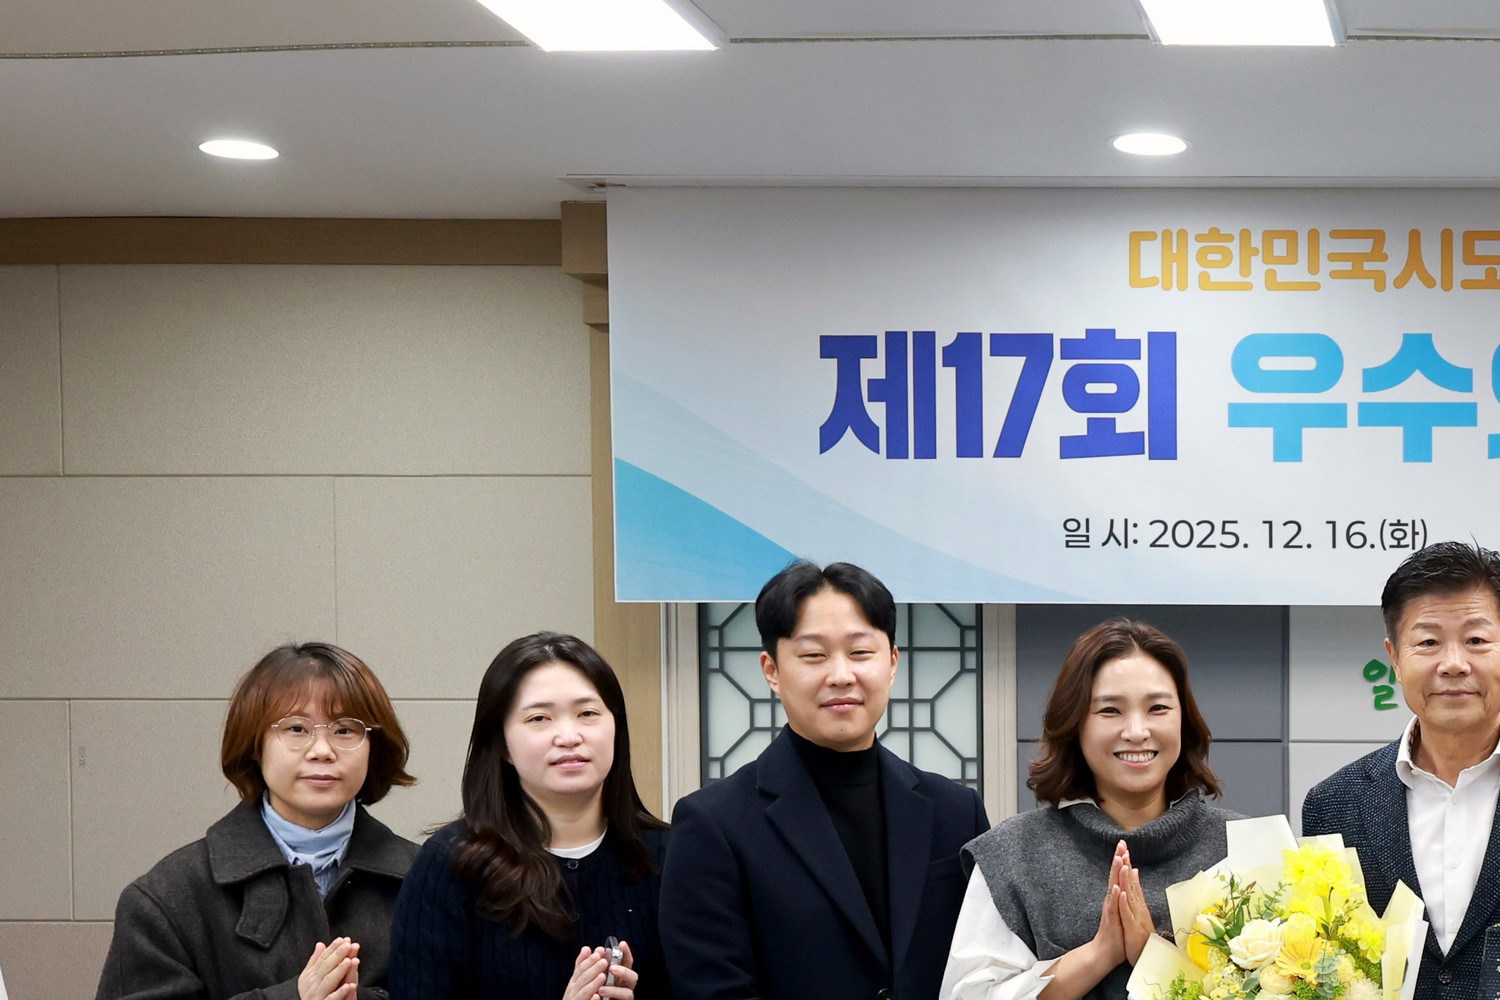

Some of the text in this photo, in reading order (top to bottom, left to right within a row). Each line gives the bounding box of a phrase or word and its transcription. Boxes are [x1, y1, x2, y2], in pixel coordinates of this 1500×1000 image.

[818, 328, 1179, 461] 제17회
[1148, 518, 1249, 549] 2025.
[1261, 518, 1312, 549] 12.
[1325, 517, 1429, 551] 16.(화)
